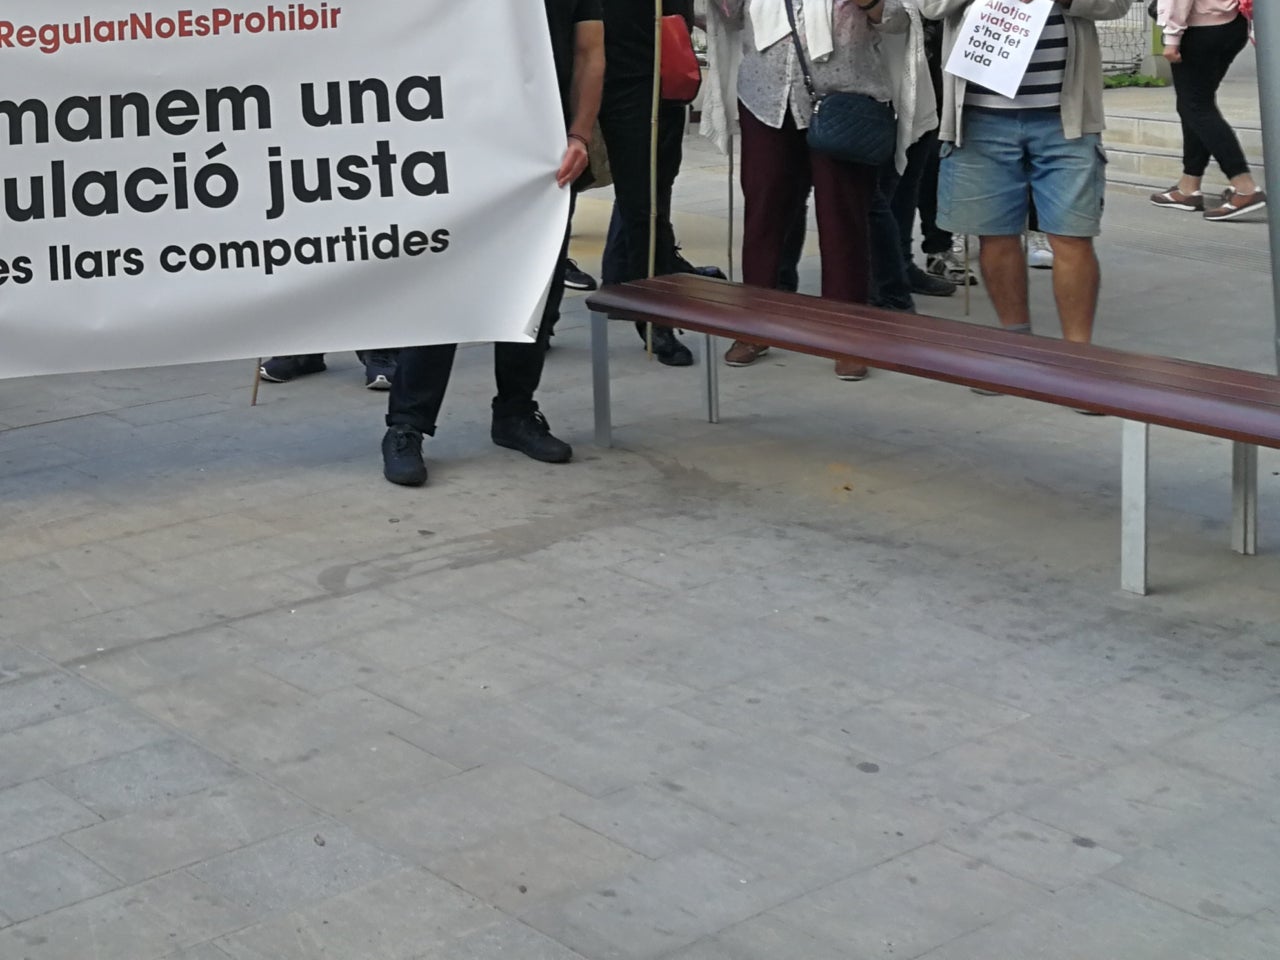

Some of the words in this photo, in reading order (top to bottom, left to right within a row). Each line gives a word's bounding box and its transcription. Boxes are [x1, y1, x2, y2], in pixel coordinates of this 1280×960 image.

[985, 0, 1032, 22] Allotjar
[980, 12, 1030, 38] viatgers
[968, 36, 995, 53] tota
[998, 47, 1010, 59] la
[1004, 34, 1021, 48] fet
[964, 50, 992, 67] vida
[301, 73, 444, 128] una
[265, 139, 449, 221] justa
[49, 242, 145, 283] llars
[159, 221, 450, 275] compartides
